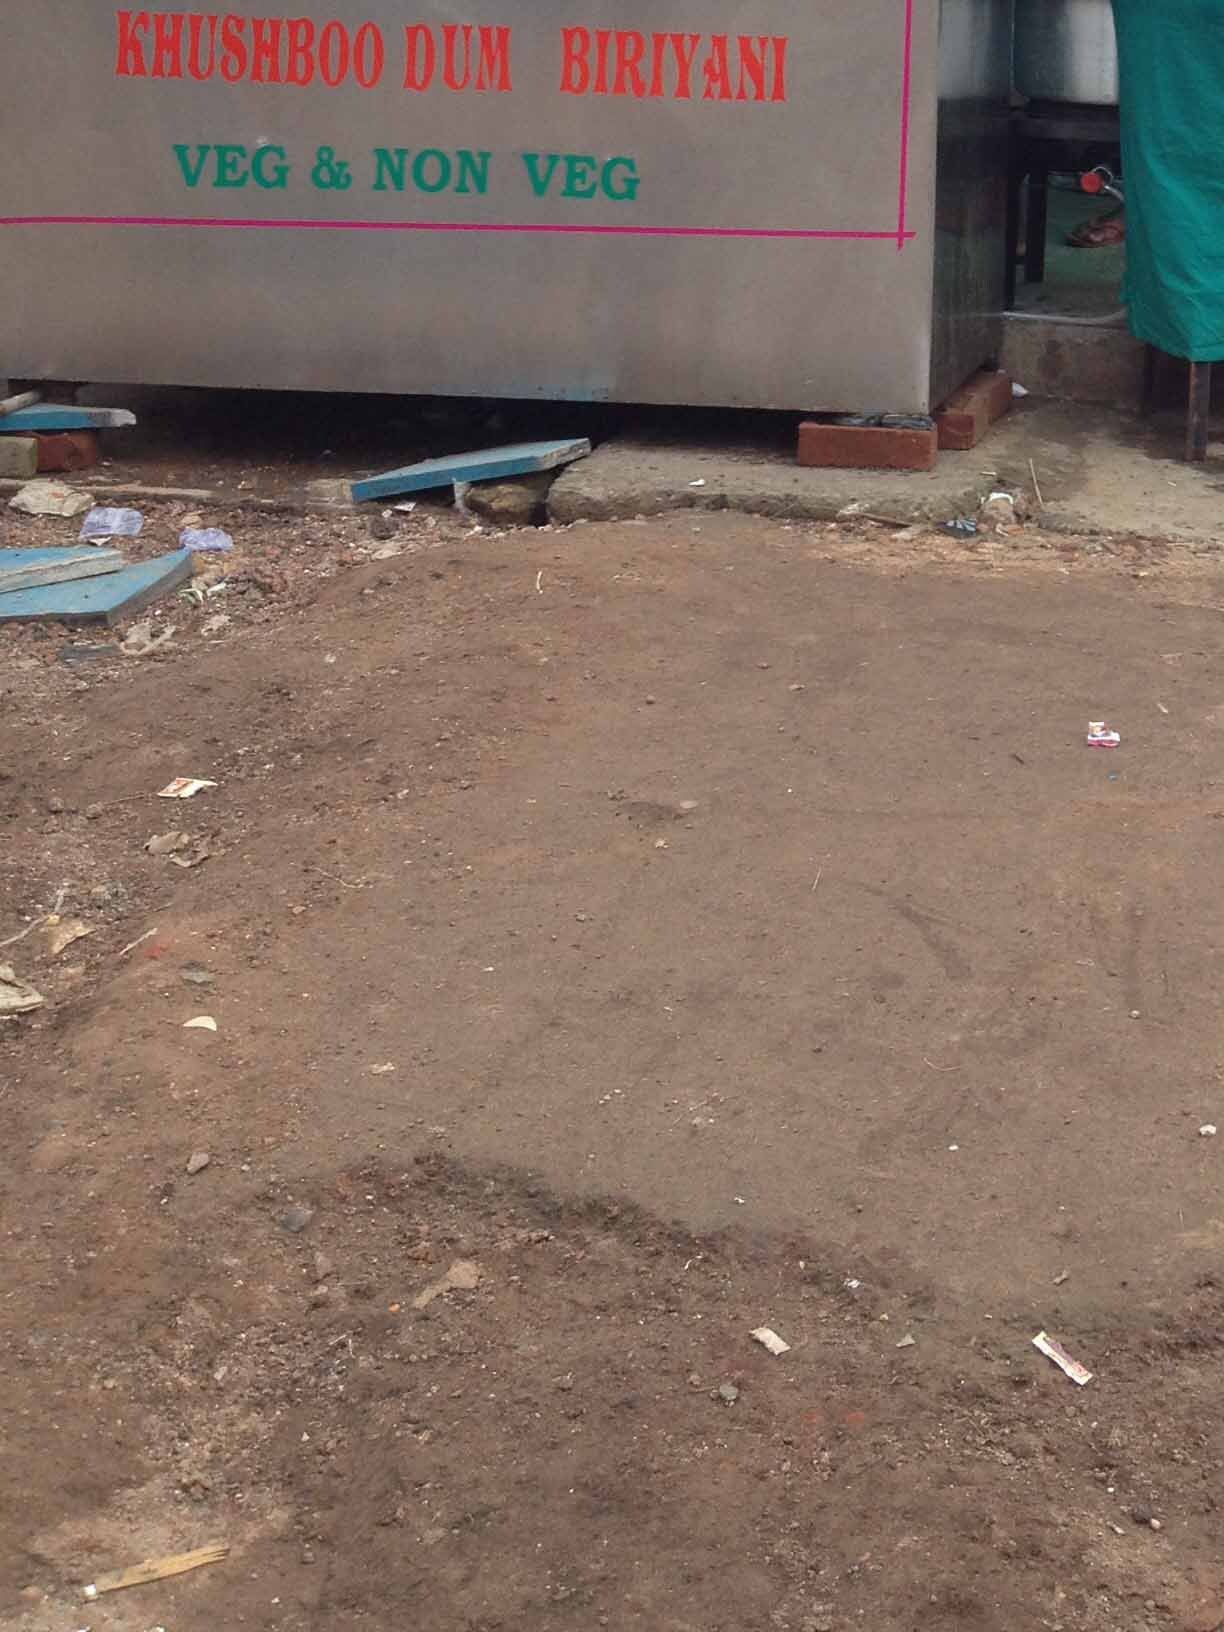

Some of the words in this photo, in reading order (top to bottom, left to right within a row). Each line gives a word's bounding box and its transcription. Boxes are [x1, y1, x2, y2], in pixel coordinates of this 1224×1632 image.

[113, 9, 385, 89] KHUSHBOO
[402, 22, 512, 94] DUM
[558, 26, 790, 105] BIRIYANI
[173, 142, 290, 192] VEG
[311, 146, 352, 192] &
[372, 148, 492, 198] NON
[521, 152, 641, 203] VEG
